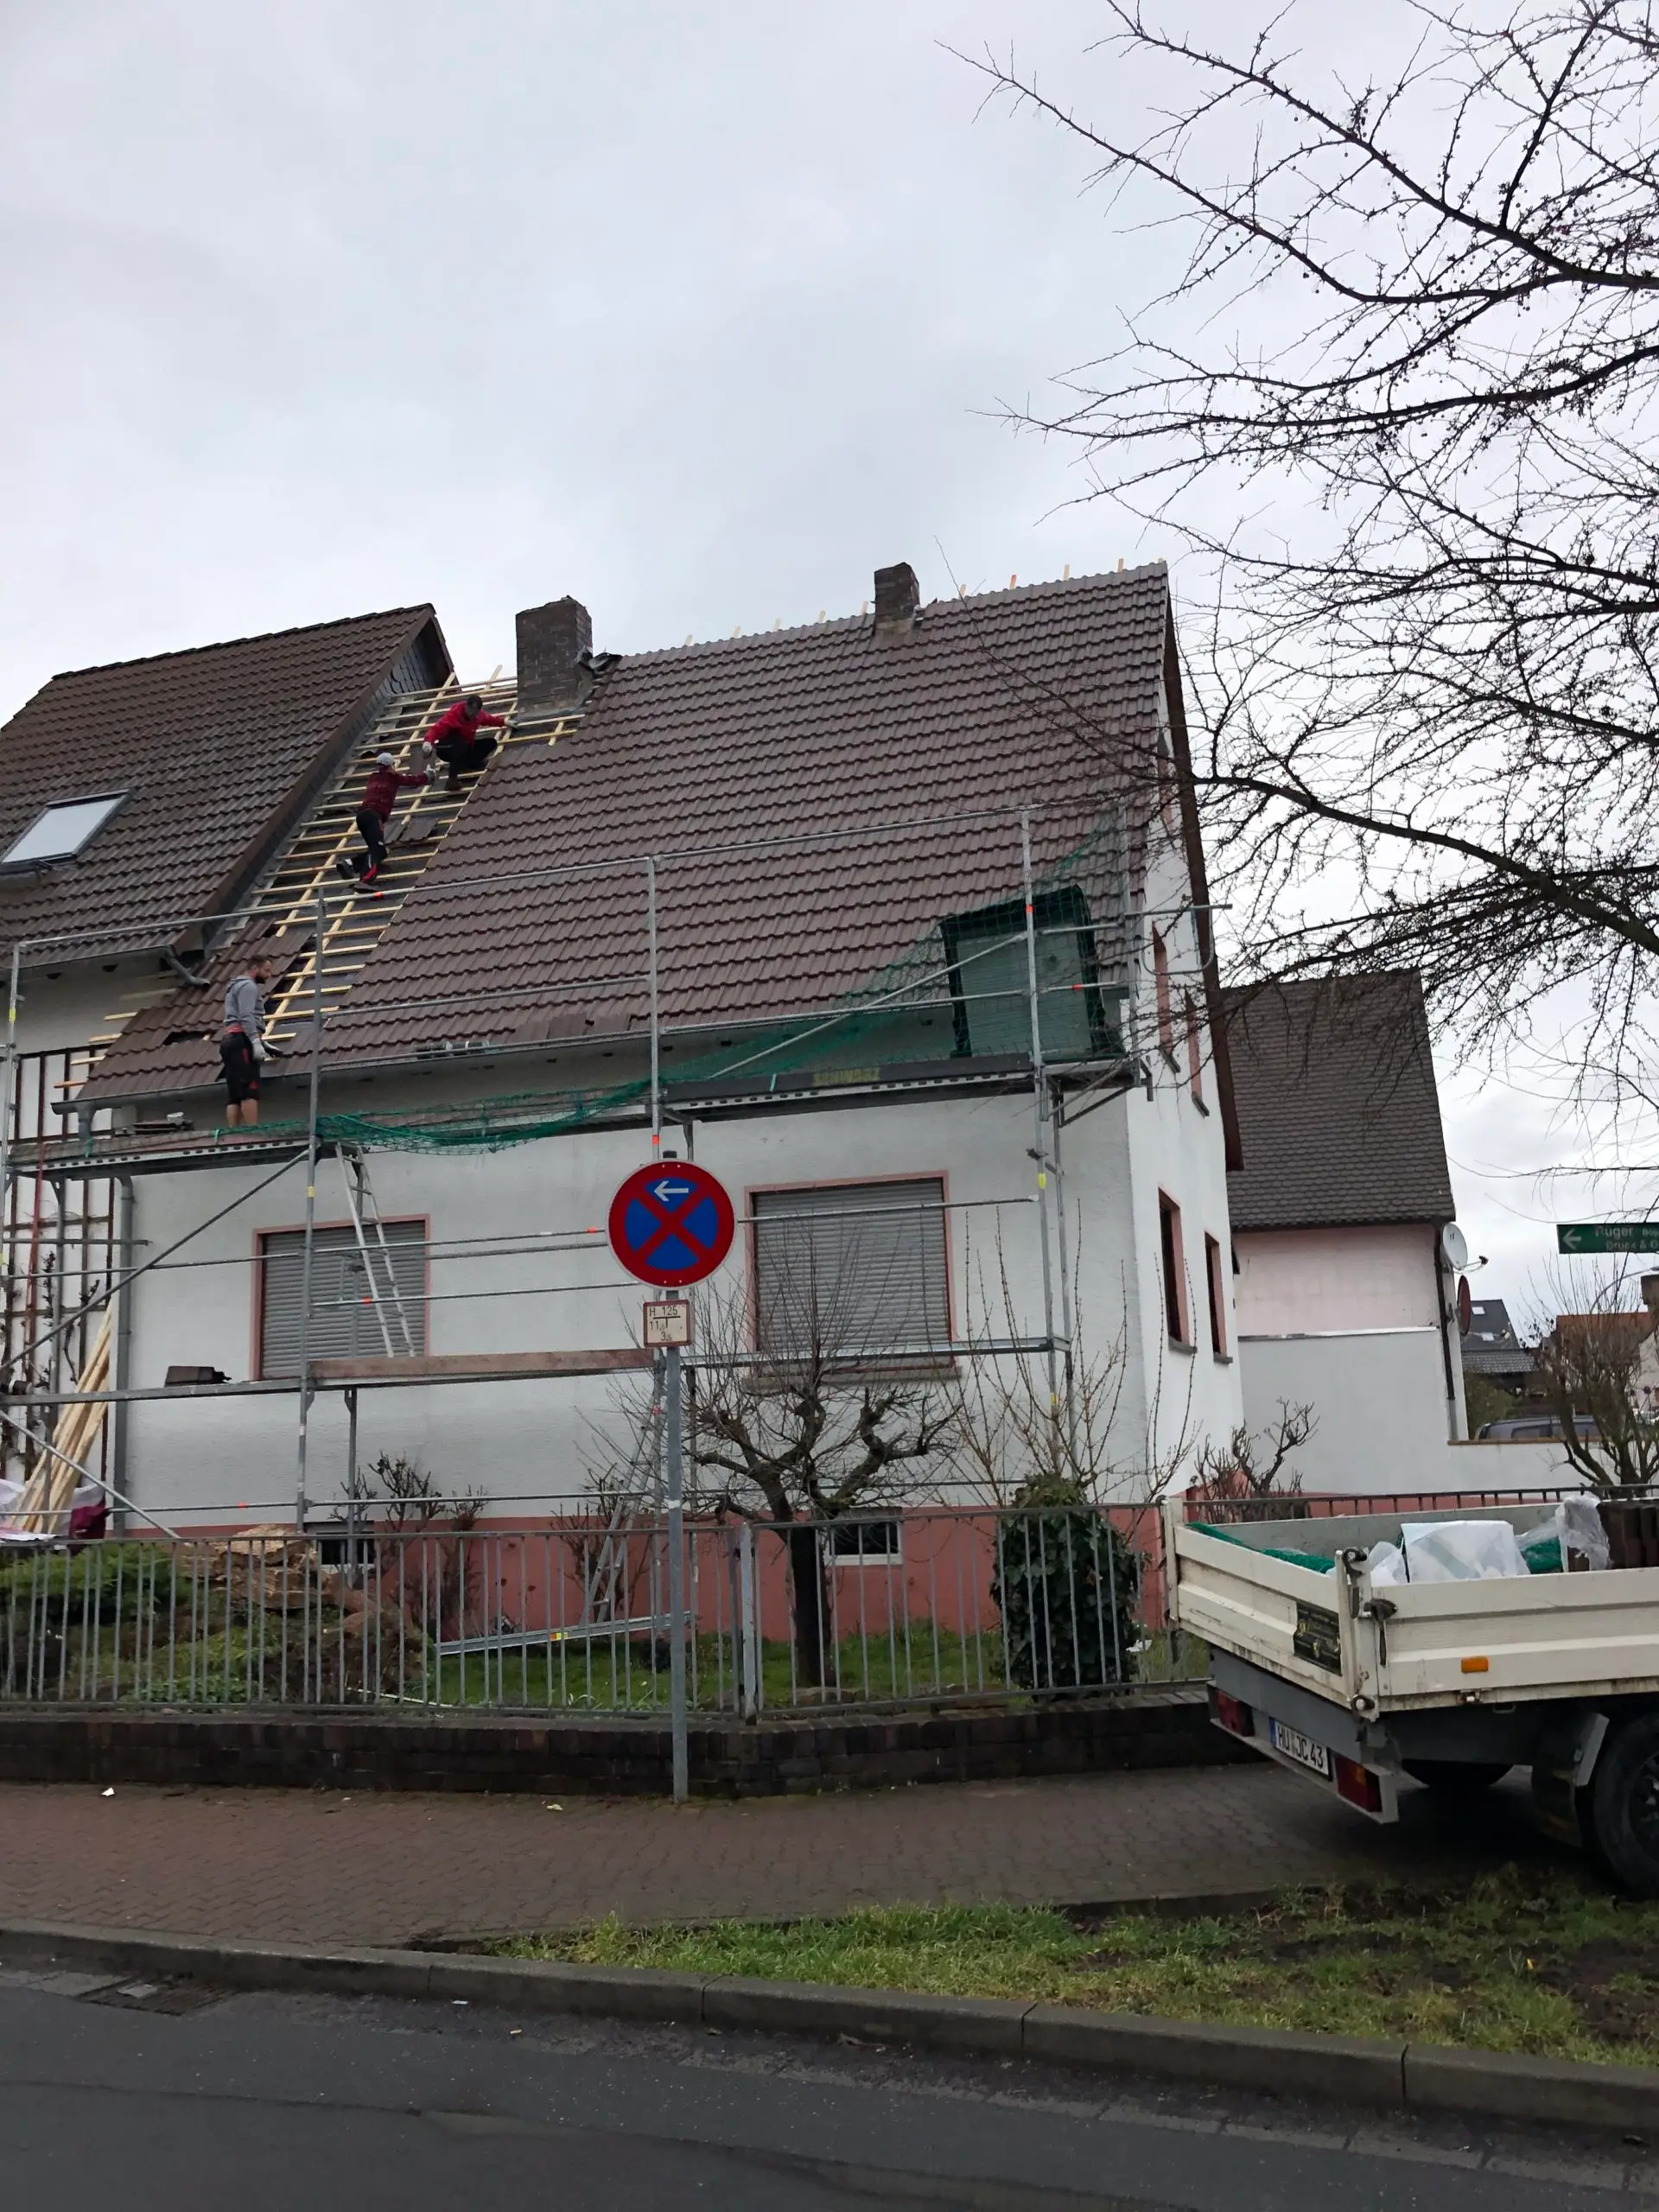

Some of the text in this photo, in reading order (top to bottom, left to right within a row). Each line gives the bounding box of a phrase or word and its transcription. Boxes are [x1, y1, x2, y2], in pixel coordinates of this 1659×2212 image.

[649, 1306, 678, 1317] H 125
[1278, 1726, 1291, 1751] HU
[1310, 1744, 1324, 1769] 43
